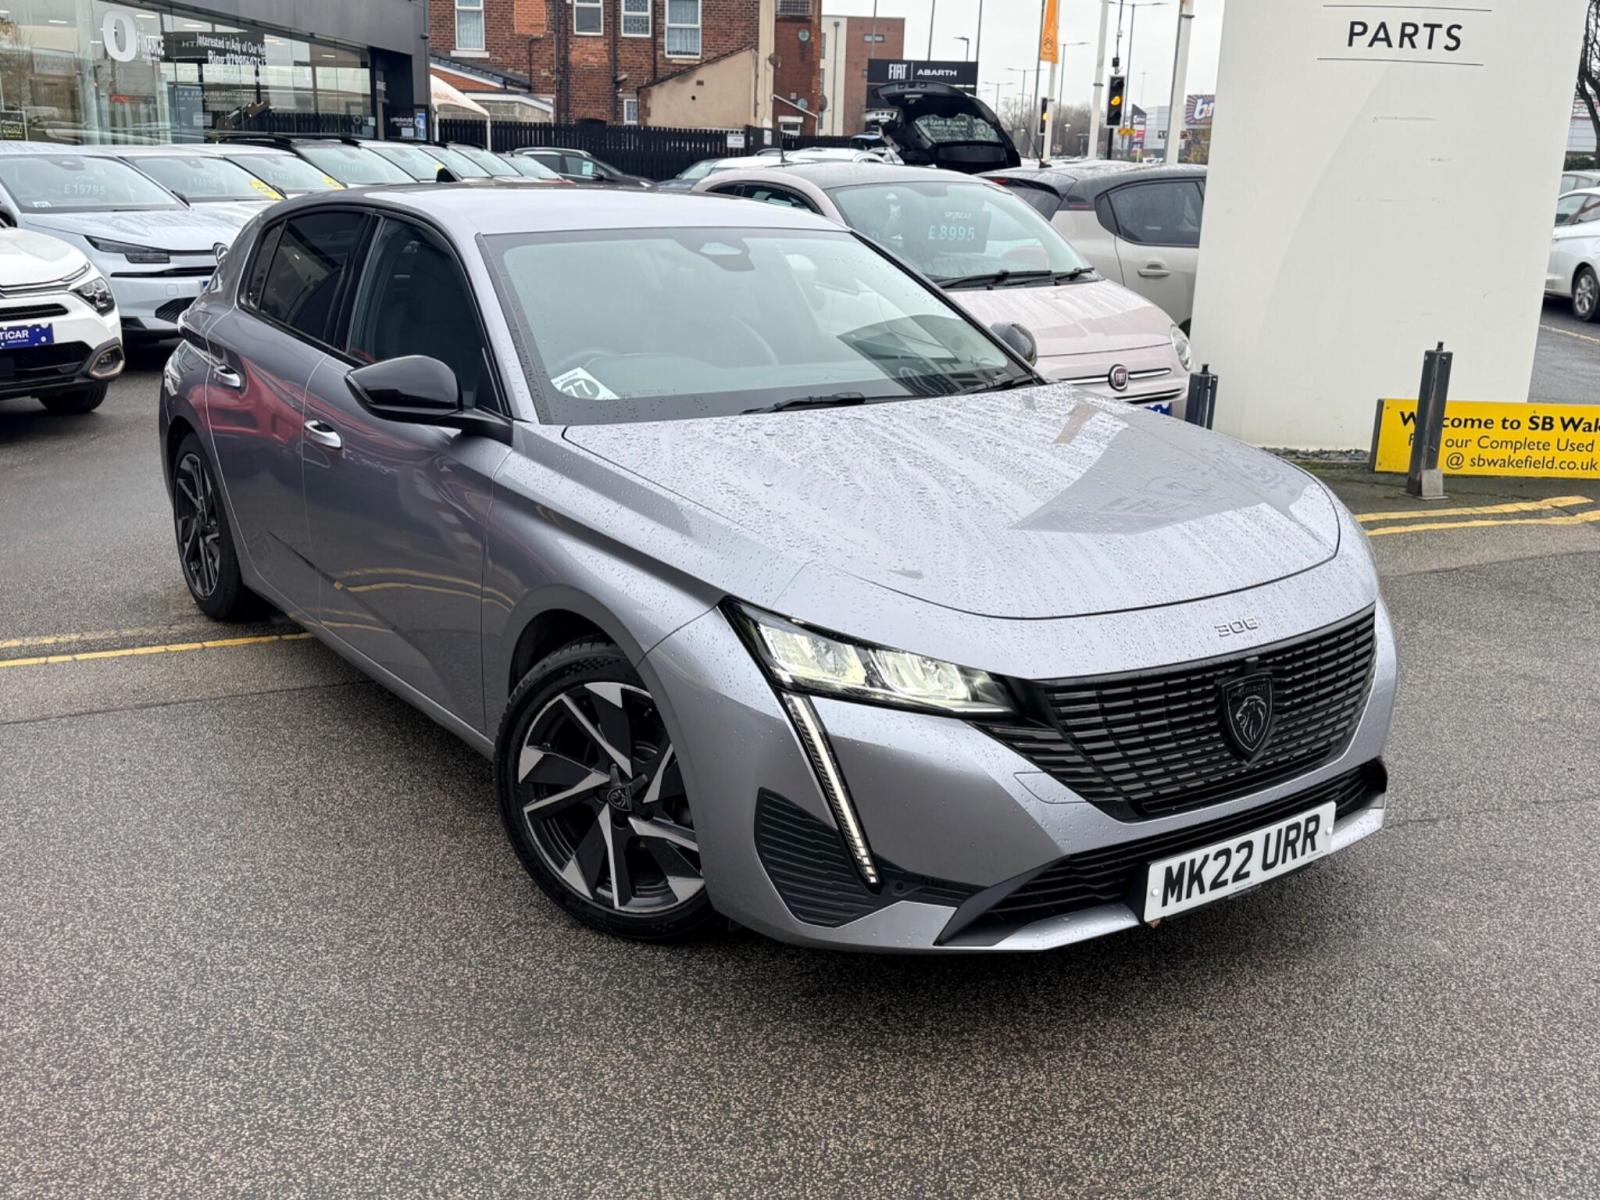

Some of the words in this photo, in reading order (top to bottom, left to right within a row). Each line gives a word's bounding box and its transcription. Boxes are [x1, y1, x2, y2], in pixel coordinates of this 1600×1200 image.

[1347, 20, 1464, 52] PARTS
[888, 63, 908, 80] FIAT
[916, 68, 958, 77] ABARTH
[927, 224, 976, 241] £8995
[1399, 410, 1495, 430] Wcome
[1501, 416, 1521, 431] to
[1527, 415, 1555, 432] SB
[1444, 438, 1472, 449] our
[1477, 435, 1551, 454] Complete
[1556, 437, 1596, 453] Used
[1446, 452, 1465, 470] @
[1469, 453, 1598, 472] sbwakefield.co.uk
[1161, 839, 1254, 908] MK22
[1261, 813, 1321, 872] URR
